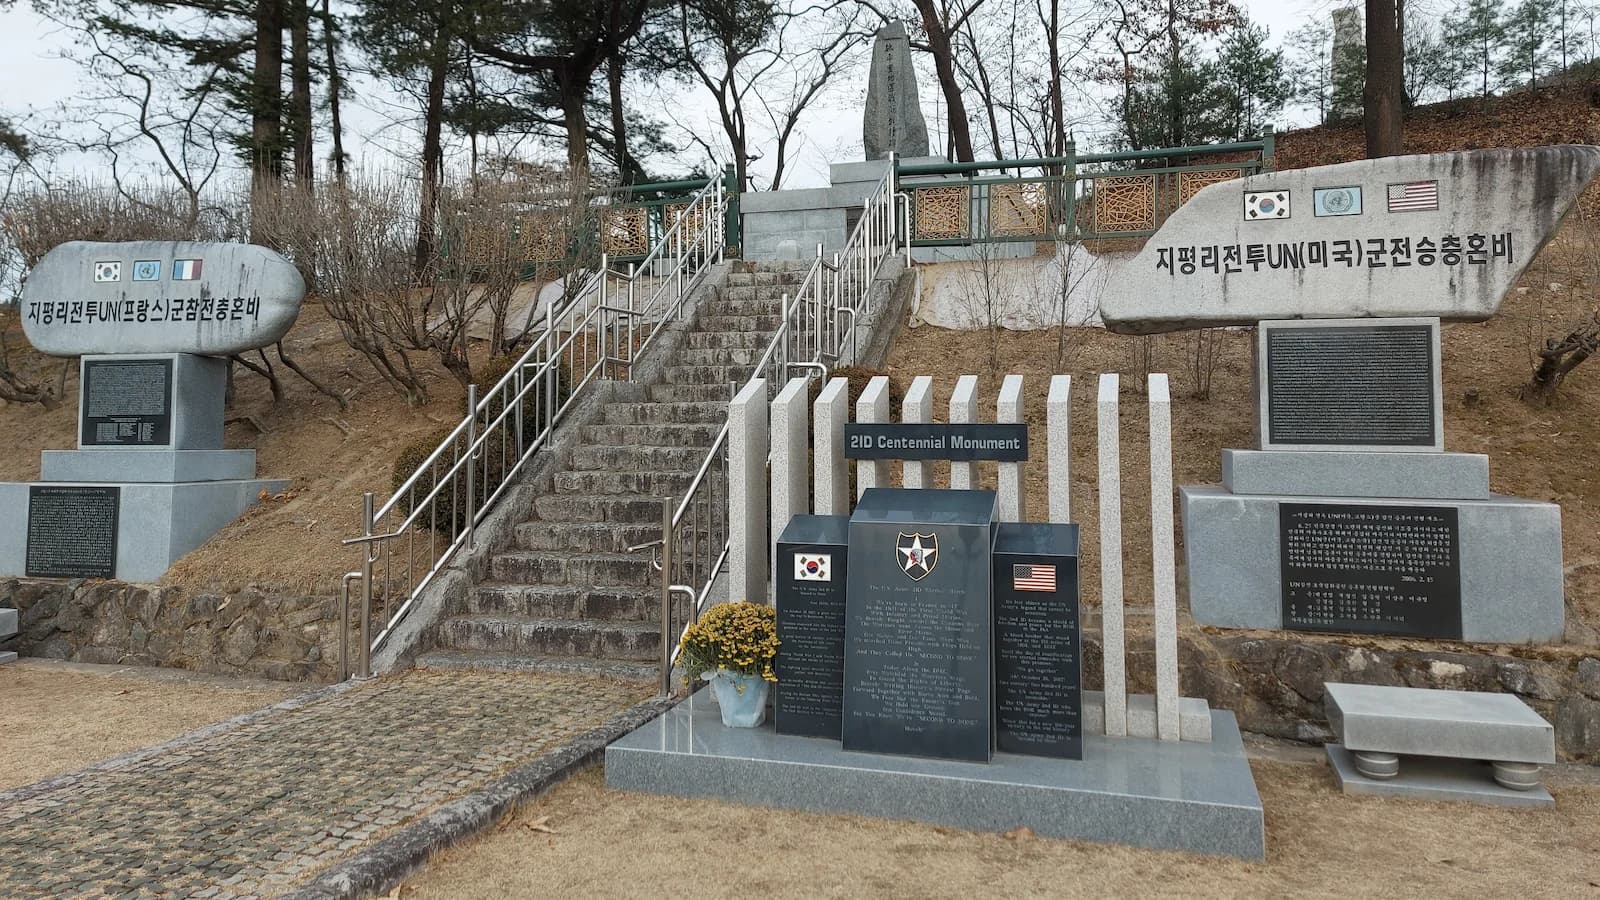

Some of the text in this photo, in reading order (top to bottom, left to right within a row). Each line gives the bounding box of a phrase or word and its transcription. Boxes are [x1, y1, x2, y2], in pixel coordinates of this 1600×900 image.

[1155, 232, 1514, 276] 지평리전투UN(미국)군전승충혼비
[28, 297, 260, 324] 지평리전투UN(프랑스)군참전충혼비
[877, 435, 946, 449] Centennial
[950, 435, 1021, 450] Monument
